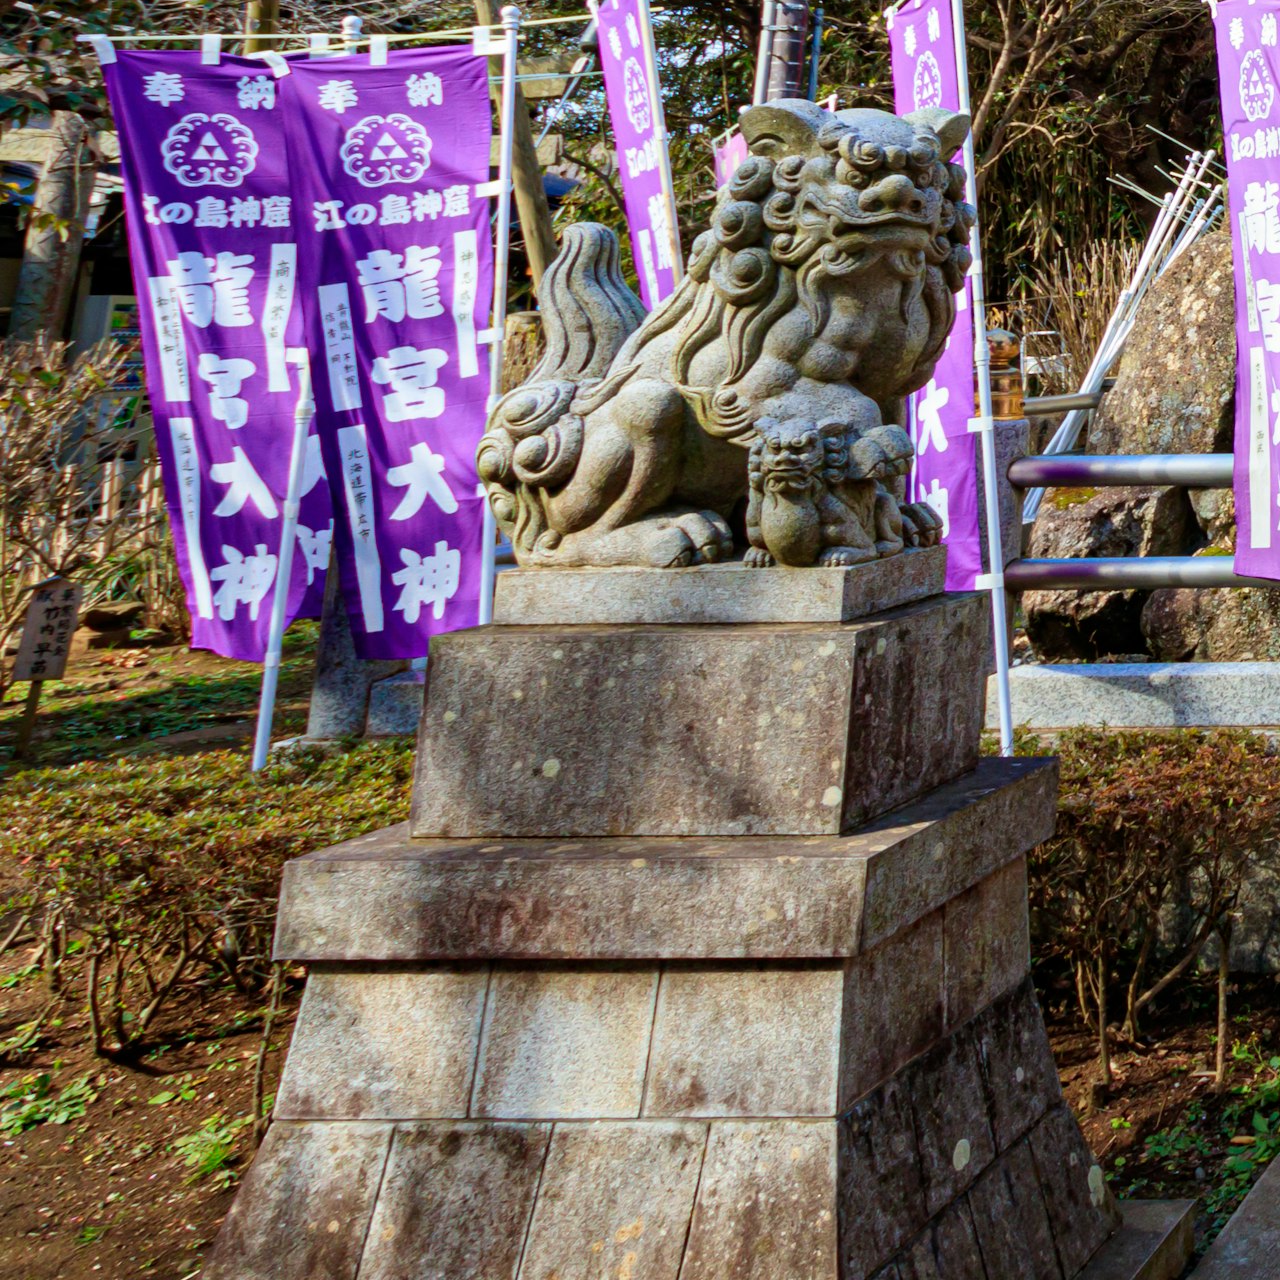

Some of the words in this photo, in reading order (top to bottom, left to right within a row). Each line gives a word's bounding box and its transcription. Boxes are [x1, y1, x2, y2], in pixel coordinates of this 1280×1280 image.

[143, 71, 275, 110] 奉納
[318, 72, 443, 113] 奉納
[314, 185, 470, 232] 江の島神窟
[167, 251, 279, 620] 龍宮大神
[356, 245, 461, 623] 龍宮大神
[347, 448, 371, 544] 北海道帯広市
